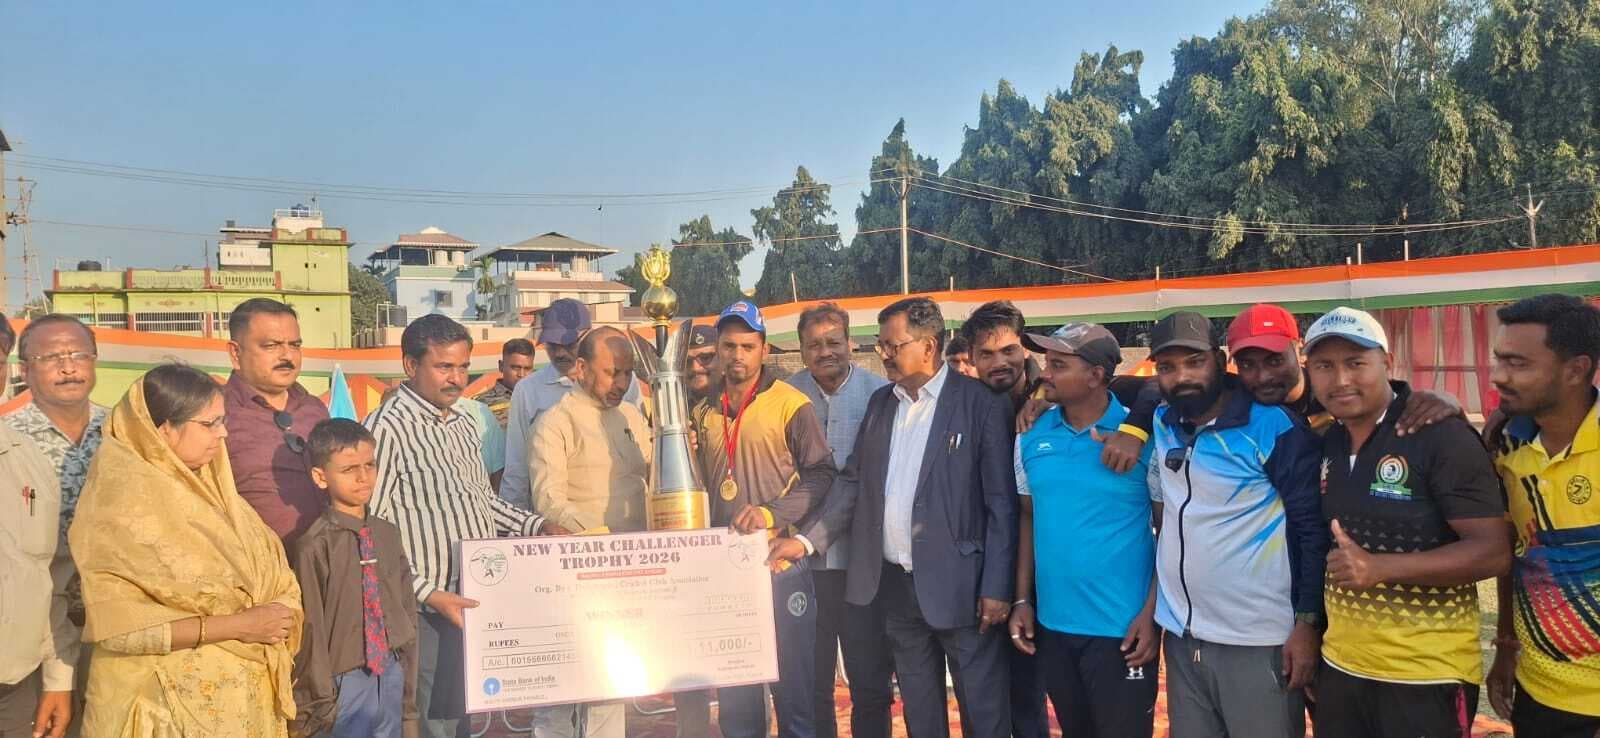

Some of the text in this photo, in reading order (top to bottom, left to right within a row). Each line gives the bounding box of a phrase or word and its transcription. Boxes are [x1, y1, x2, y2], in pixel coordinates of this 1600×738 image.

[513, 534, 723, 557] NEW YEAR CHALLENGER
[559, 551, 681, 570] TROPHY 2026
[488, 621, 504, 629] PAY
[489, 638, 520, 648] RUPEES
